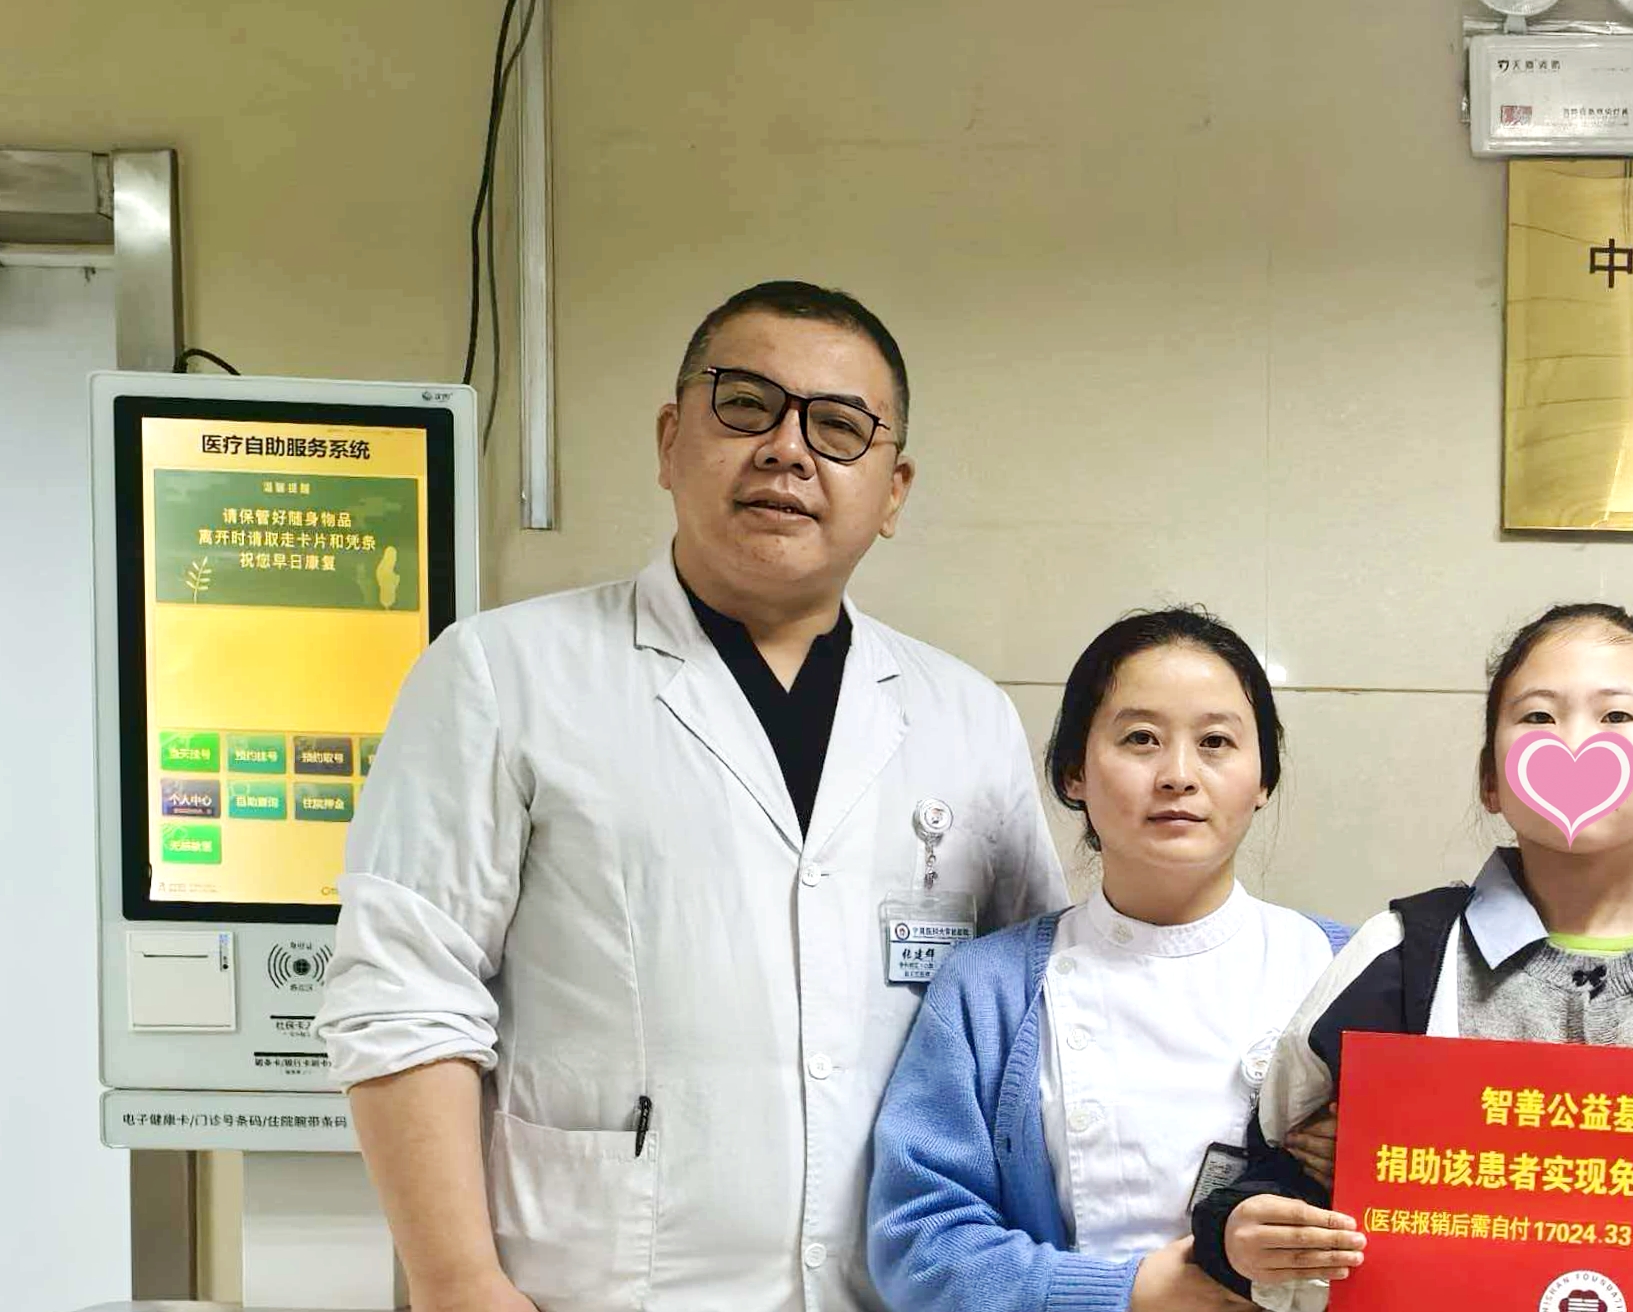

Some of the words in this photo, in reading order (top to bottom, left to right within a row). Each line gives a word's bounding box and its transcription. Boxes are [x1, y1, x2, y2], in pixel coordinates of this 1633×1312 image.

[202, 434, 371, 460] 医疗自助服务系统
[222, 507, 352, 528] 请保管好随身物品
[198, 529, 376, 551] 离开时请取走卡片和凭条
[239, 552, 337, 572] 祝您早日康复
[169, 792, 213, 807] 个人中心
